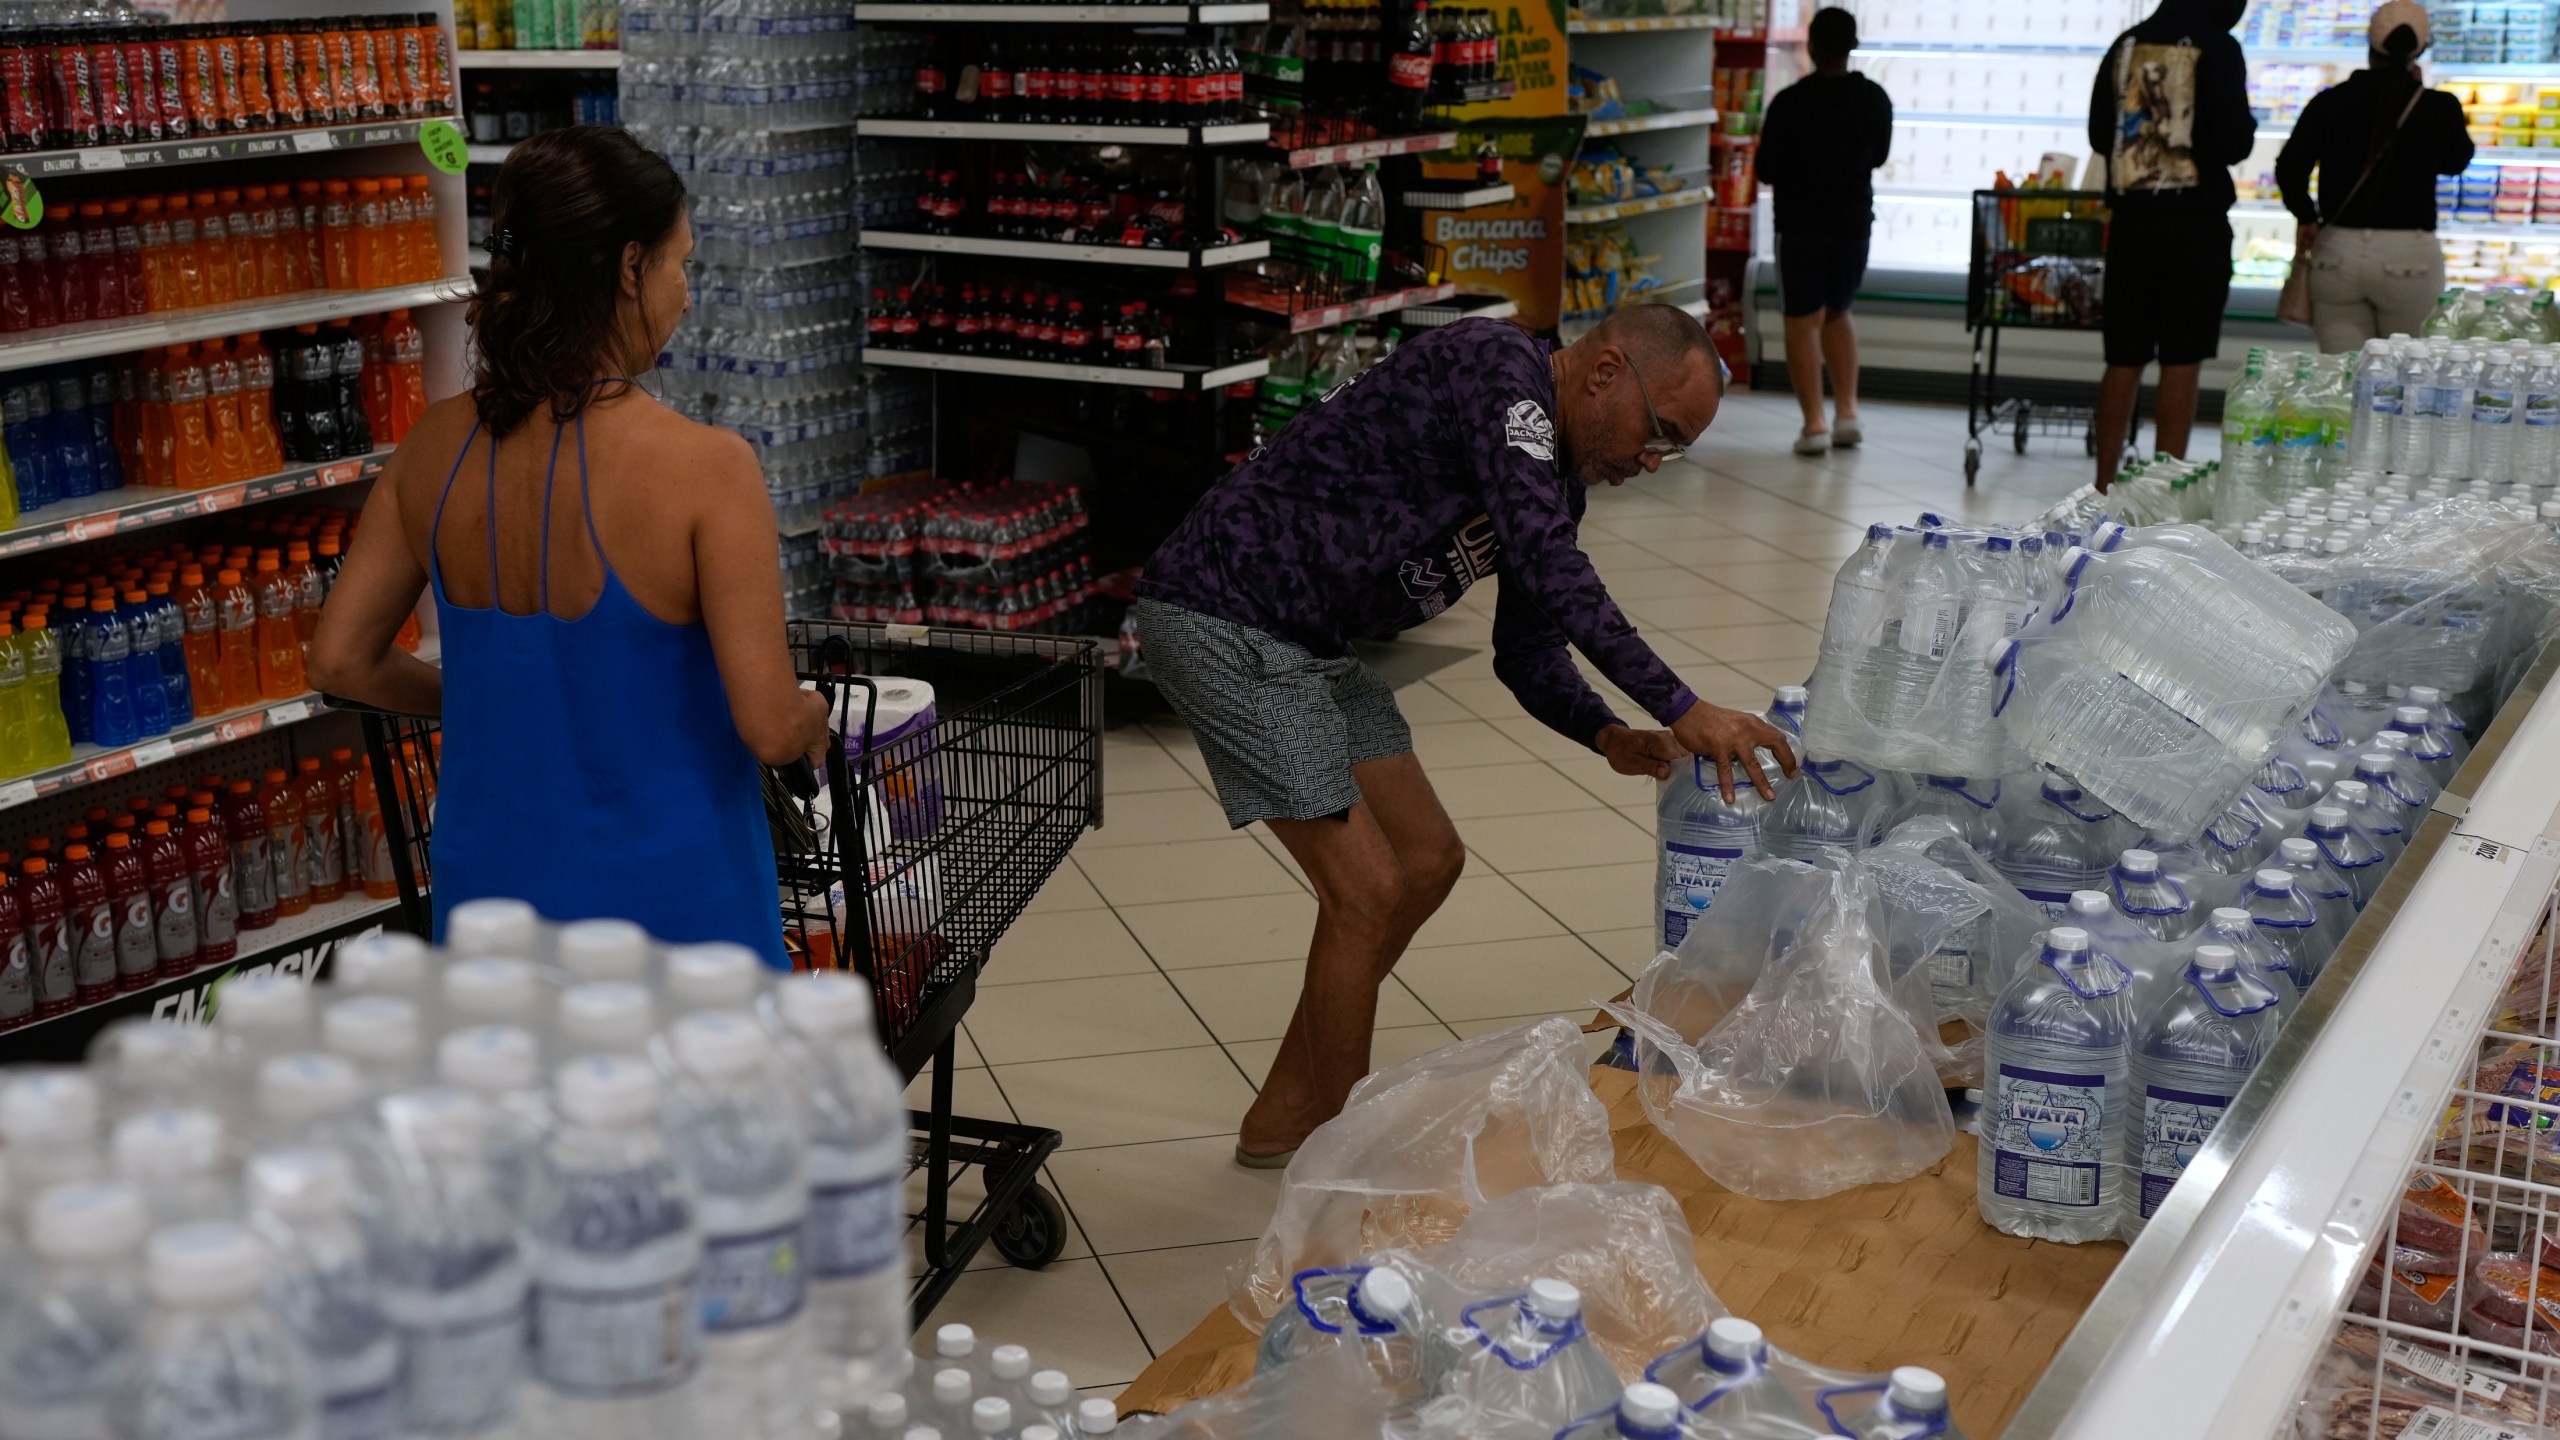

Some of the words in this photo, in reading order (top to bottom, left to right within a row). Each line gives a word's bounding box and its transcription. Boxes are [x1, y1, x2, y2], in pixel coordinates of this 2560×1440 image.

[160, 45, 182, 109] ENERGY
[170, 115, 186, 135] G
[203, 114, 216, 130] G
[178, 147, 208, 159] ENERGY
[43, 158, 75, 171] ENERGY
[1436, 216, 1547, 242] Banana
[1451, 242, 1529, 275] Chips
[323, 469, 337, 486] G
[204, 495, 217, 512] G
[73, 523, 87, 541] G
[223, 724, 237, 741] G
[93, 762, 107, 780] G
[1680, 873, 1722, 888] WATA
[168, 885, 188, 913] G
[92, 909, 112, 938] G
[127, 900, 148, 928] G
[10, 942, 26, 970] G
[2018, 1105, 2079, 1125] WATA
